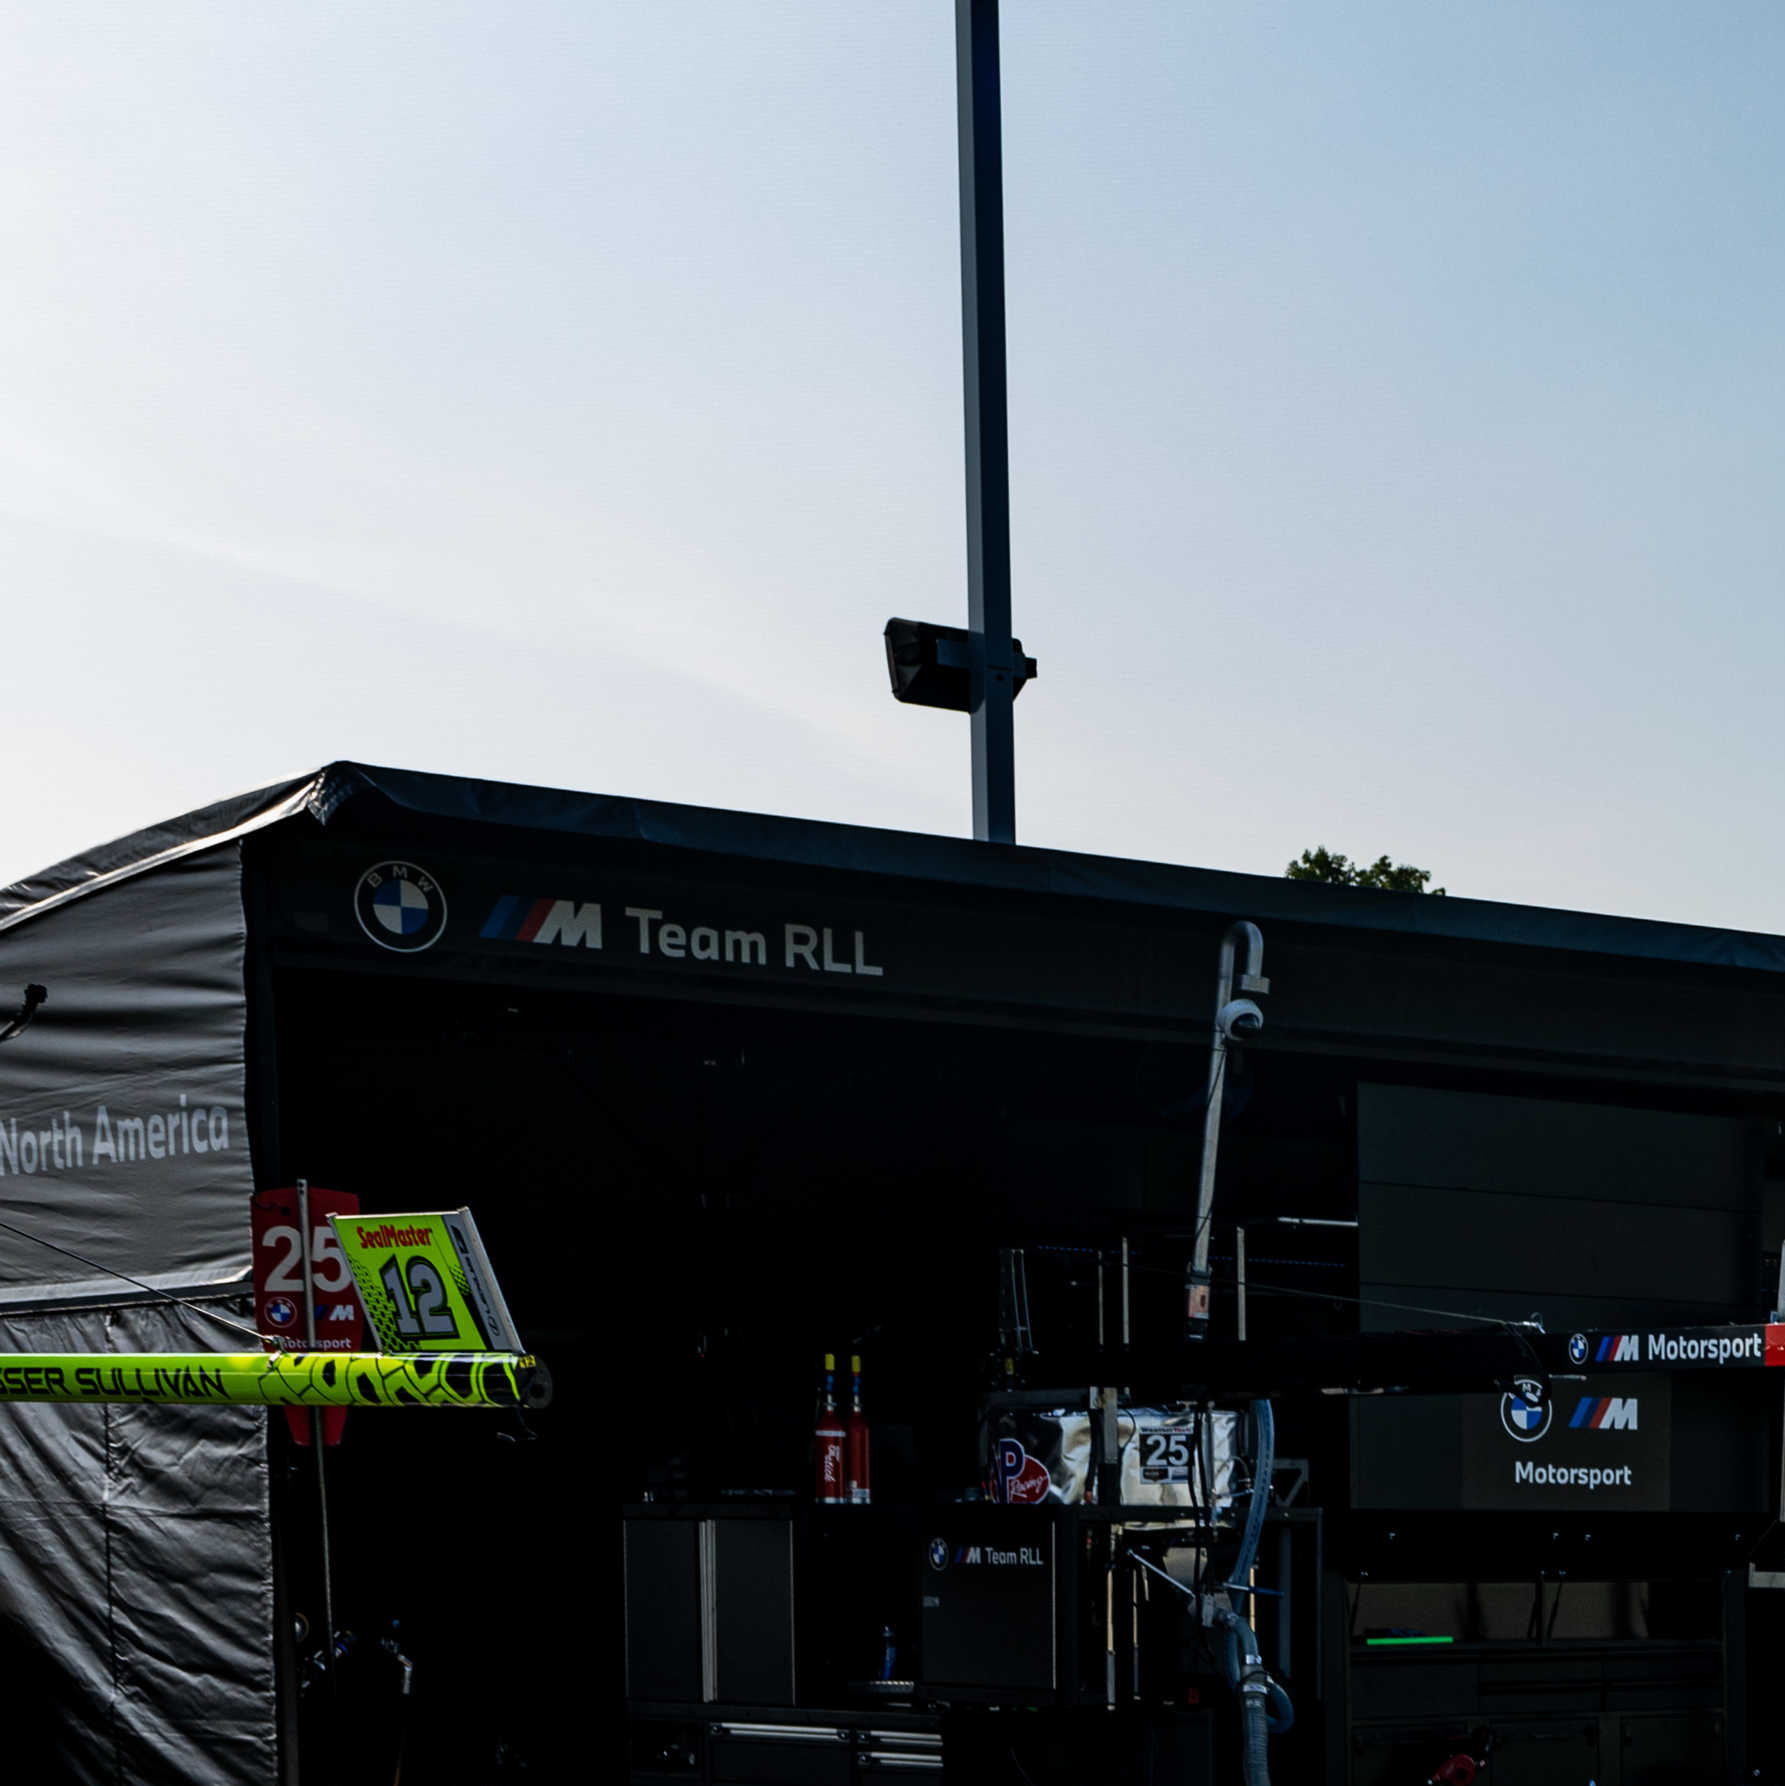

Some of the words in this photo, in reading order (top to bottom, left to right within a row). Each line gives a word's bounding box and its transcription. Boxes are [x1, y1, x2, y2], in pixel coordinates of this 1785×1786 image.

[626, 907, 767, 966] Team
[784, 923, 884, 976] RLL
[0, 1111, 83, 1176] North
[93, 1095, 230, 1166] America
[357, 1226, 432, 1249] SealMaster
[262, 1225, 352, 1293] 25
[380, 1254, 459, 1338] 12
[1647, 1333, 1762, 1366] Motorsport
[75, 1366, 230, 1398] SULLIVAN
[1145, 1435, 1189, 1466] 25
[1514, 1462, 1632, 1489] Motorsport
[985, 1548, 1017, 1564] Team
[1020, 1547, 1043, 1564] RLL
